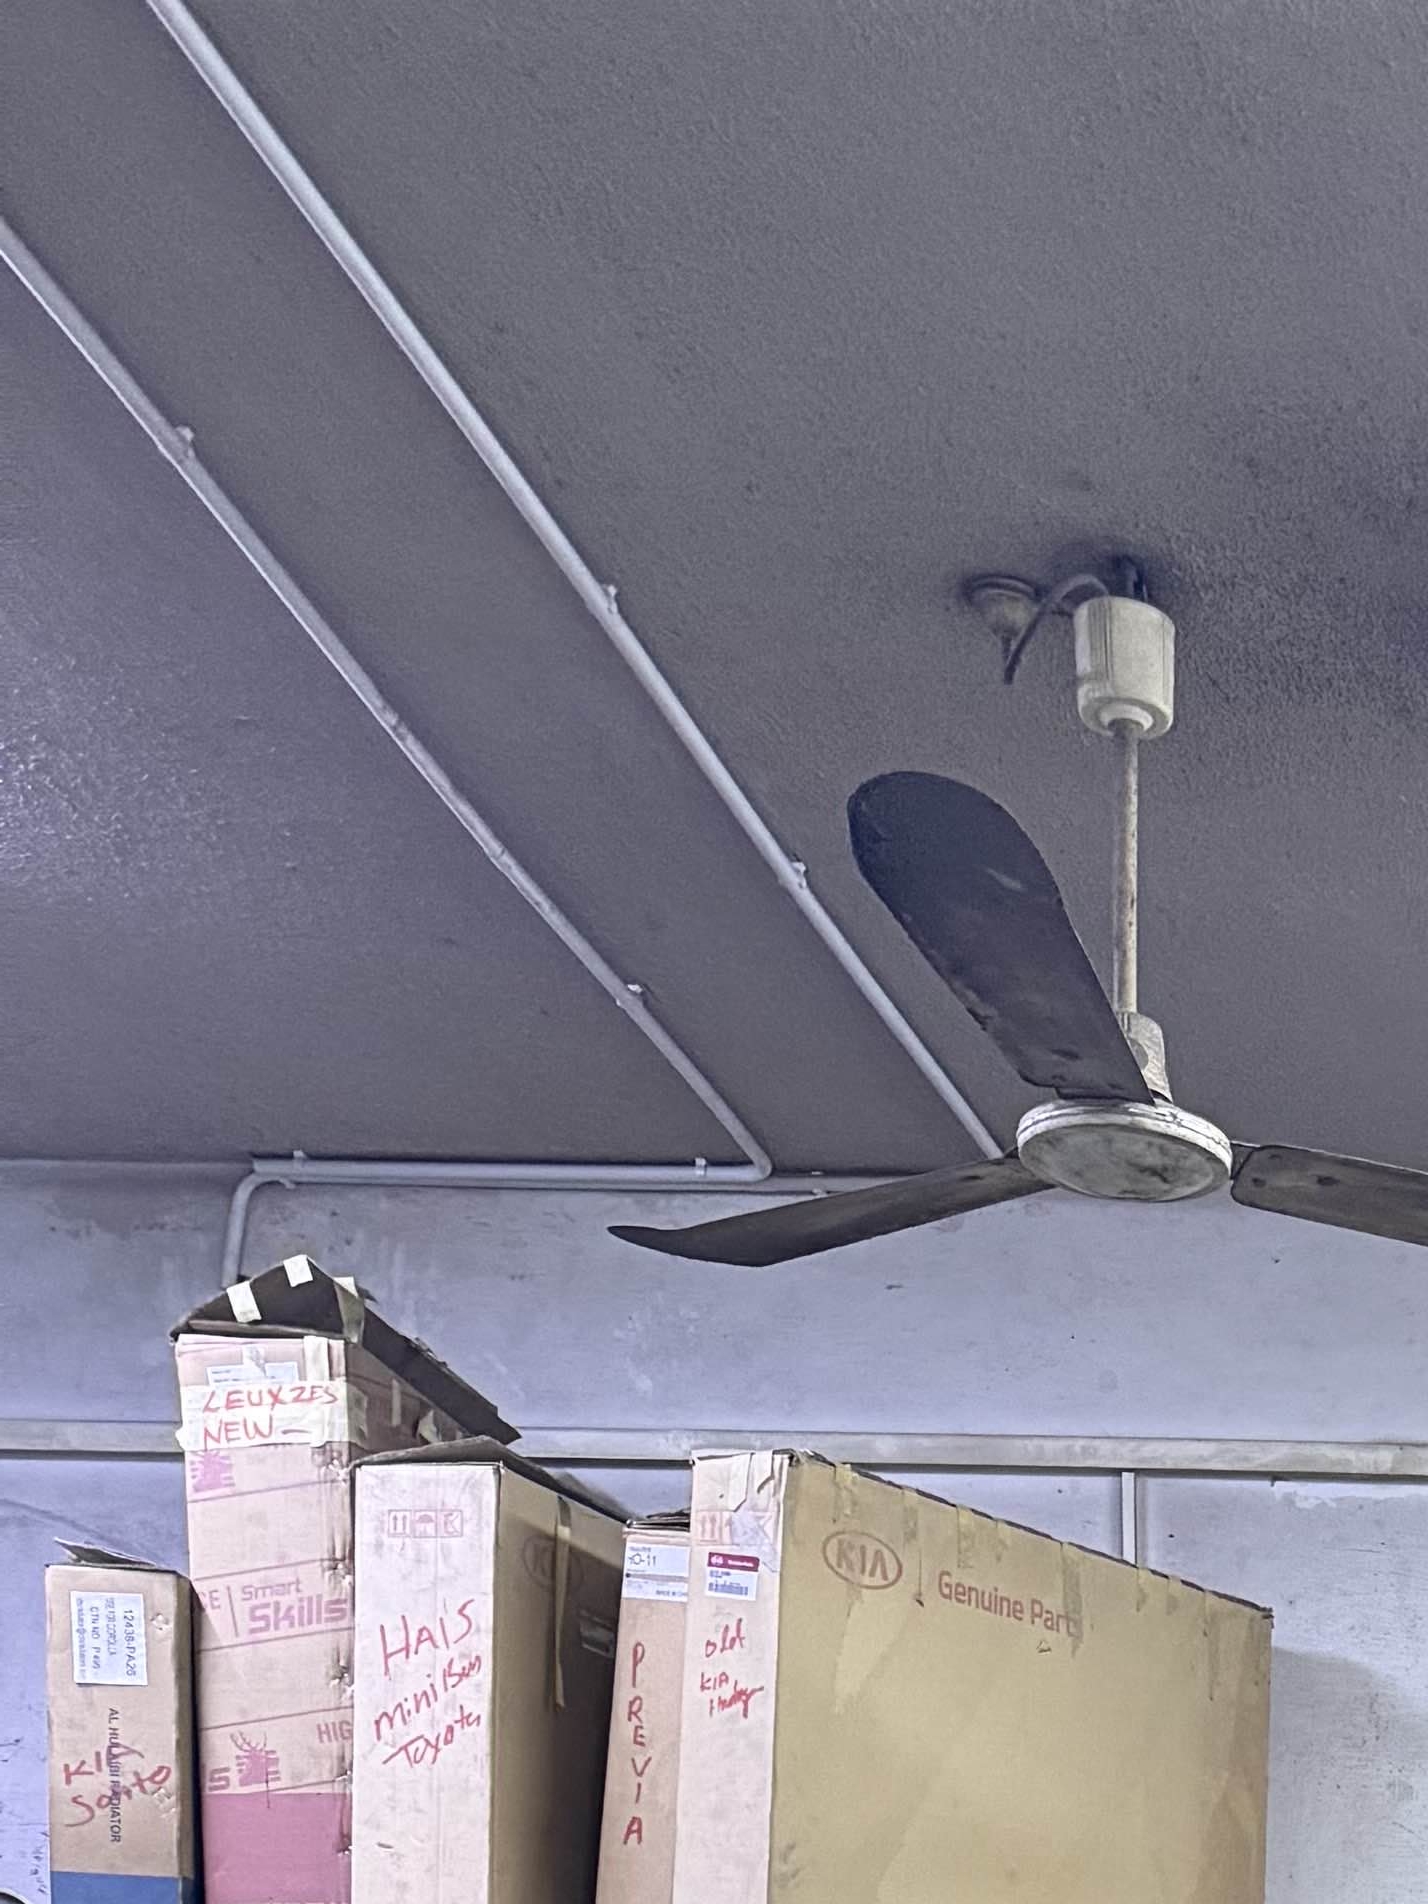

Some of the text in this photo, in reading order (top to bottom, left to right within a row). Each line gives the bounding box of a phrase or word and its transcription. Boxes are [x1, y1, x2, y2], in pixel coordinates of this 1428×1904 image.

[203, 1414, 273, 1450] NEW
[835, 1538, 889, 1581] KIA
[241, 1577, 301, 1602] Smart
[938, 1570, 1083, 1639] Genuine Part
[249, 1594, 348, 1635] Skills
[622, 1641, 653, 1846] PREVIA
